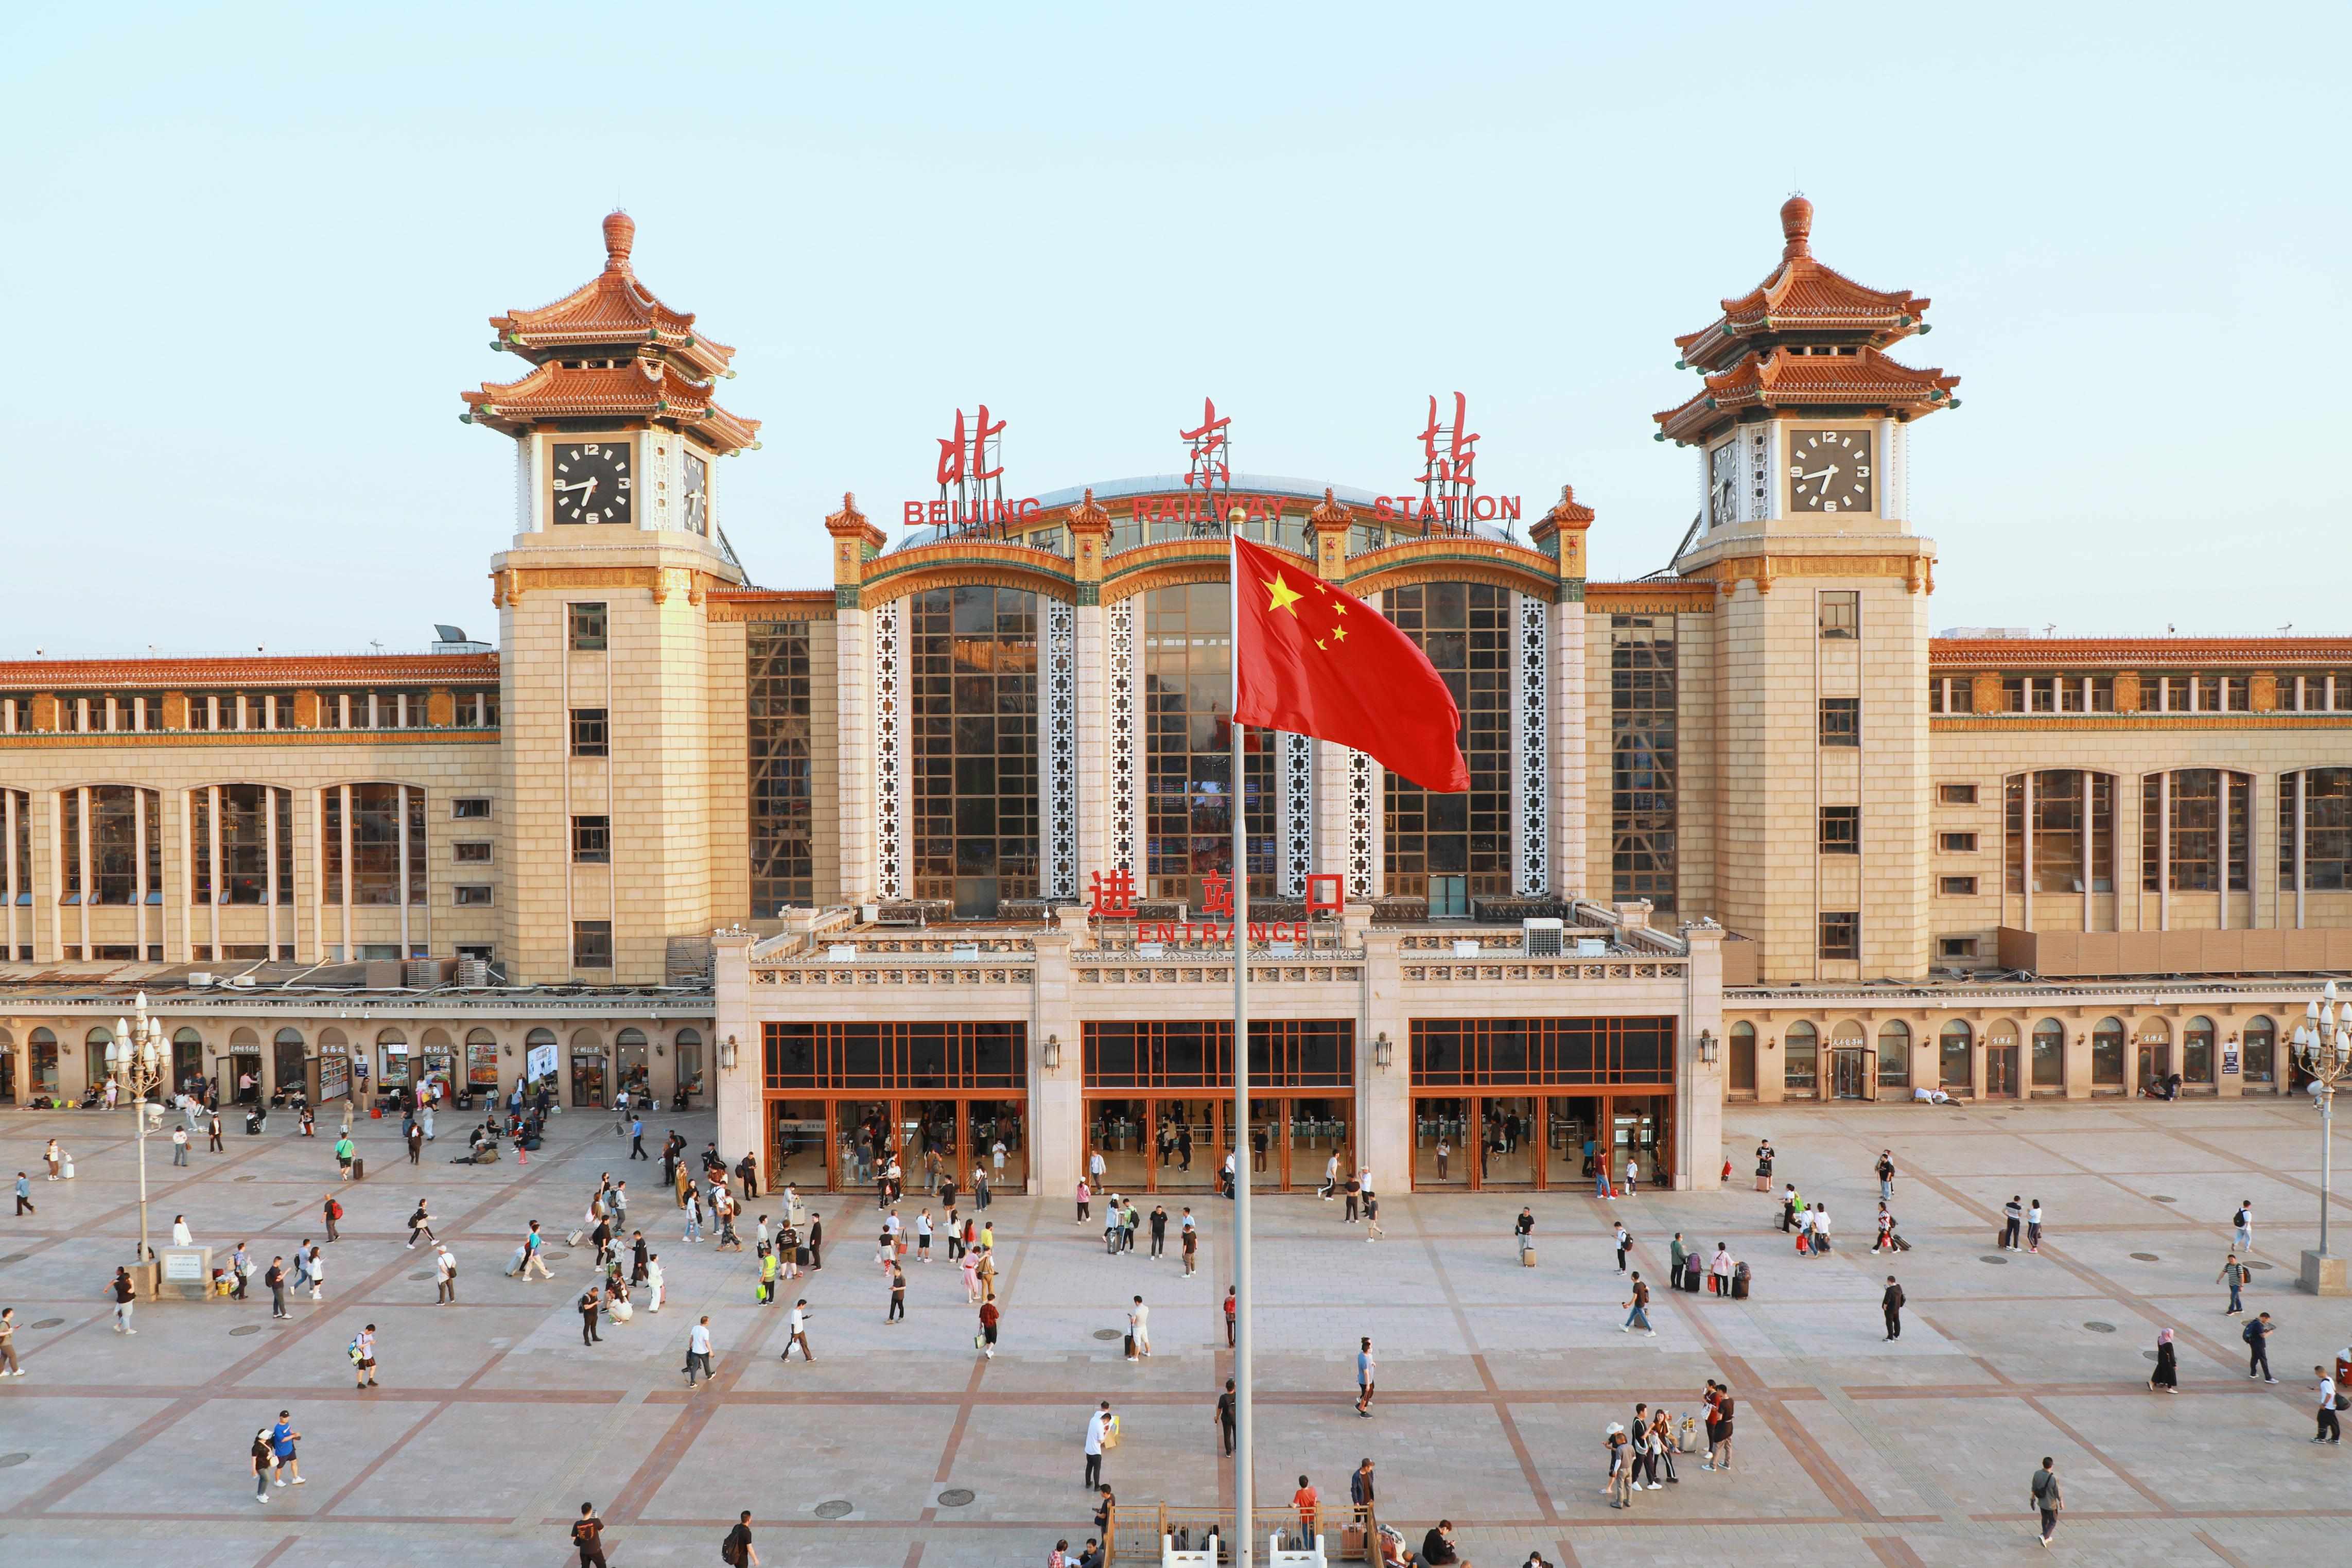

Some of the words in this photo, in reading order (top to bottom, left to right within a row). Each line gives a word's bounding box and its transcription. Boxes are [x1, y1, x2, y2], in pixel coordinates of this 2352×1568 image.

[1822, 431, 1837, 443] 12
[584, 444, 599, 455] 12
[1790, 466, 1803, 477] 9
[1857, 466, 1870, 477] 3
[553, 479, 566, 491] 9
[618, 478, 631, 489] 3
[904, 497, 1040, 525] BEIJING
[1133, 495, 1288, 522] RAILWAY
[1374, 495, 1521, 521] STATION
[1824, 501, 1837, 512] 6
[586, 513, 599, 524] 6
[1089, 868, 1344, 918] 进站口
[321, 1046, 346, 1054] 寄存处
[424, 1046, 449, 1054] 便利店
